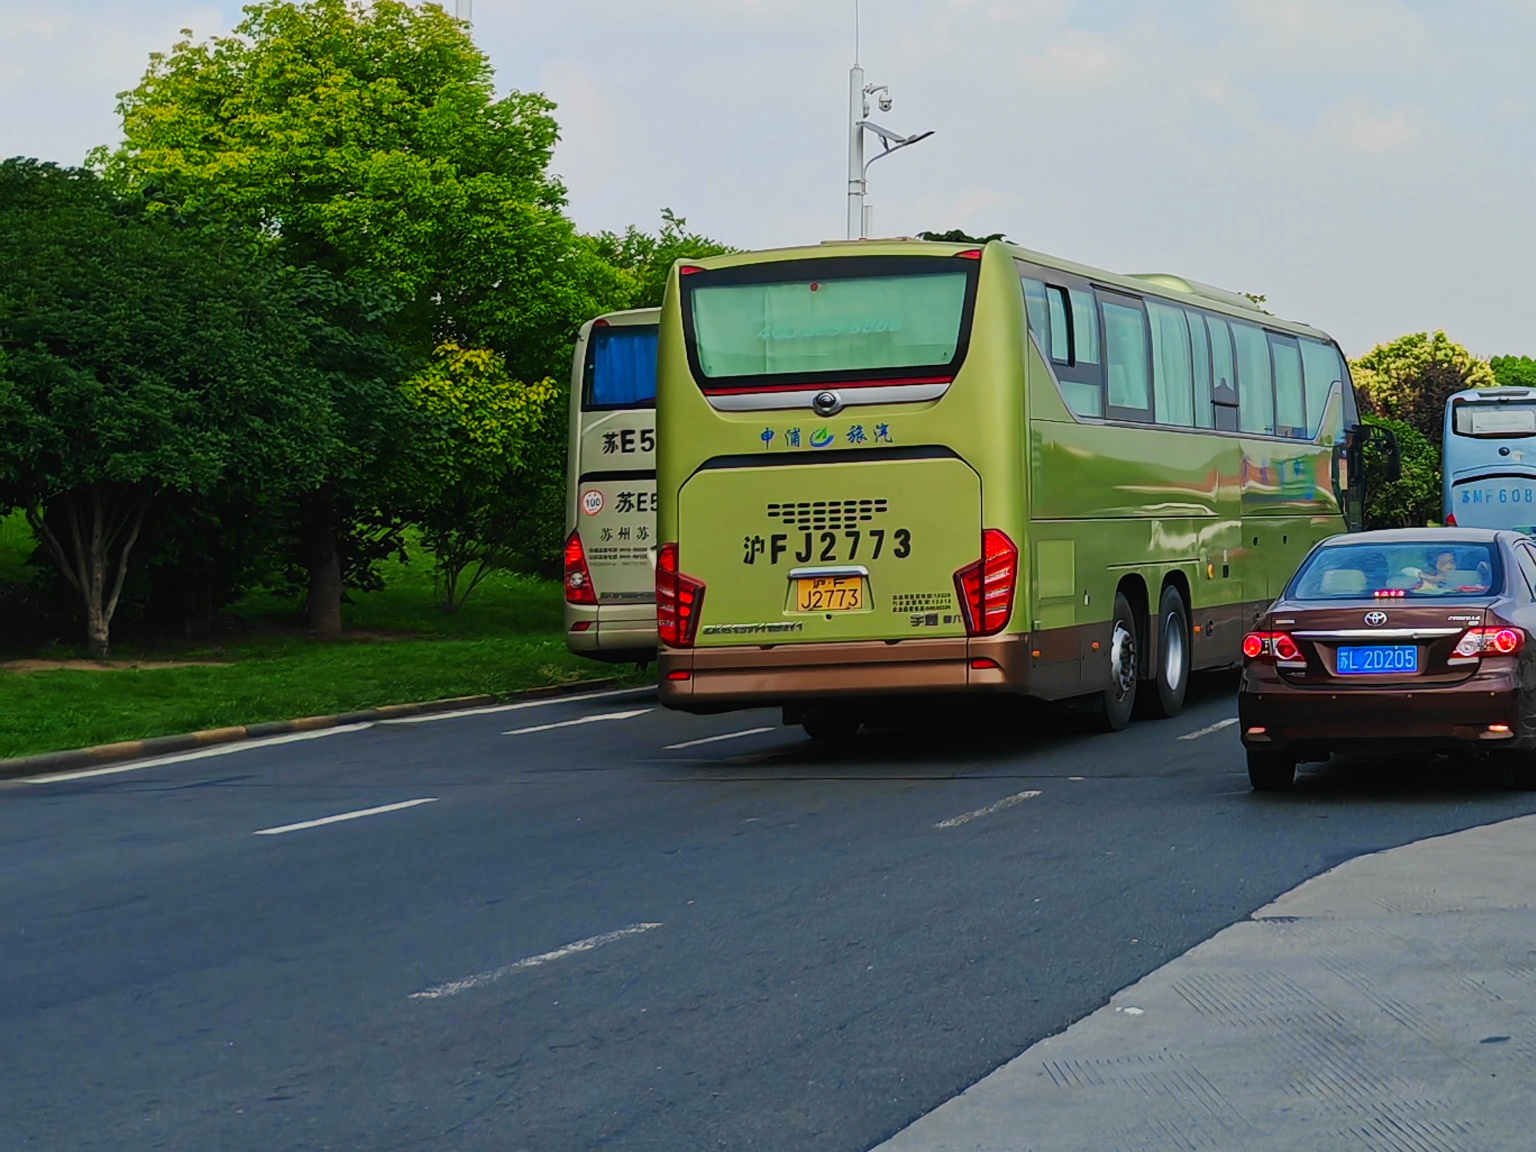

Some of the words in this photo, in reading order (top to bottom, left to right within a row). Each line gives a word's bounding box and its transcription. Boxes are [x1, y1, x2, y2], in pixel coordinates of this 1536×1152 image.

[602, 428, 655, 455] 苏E5
[743, 528, 912, 565] 沪FJ2773
[801, 589, 858, 609] J2773
